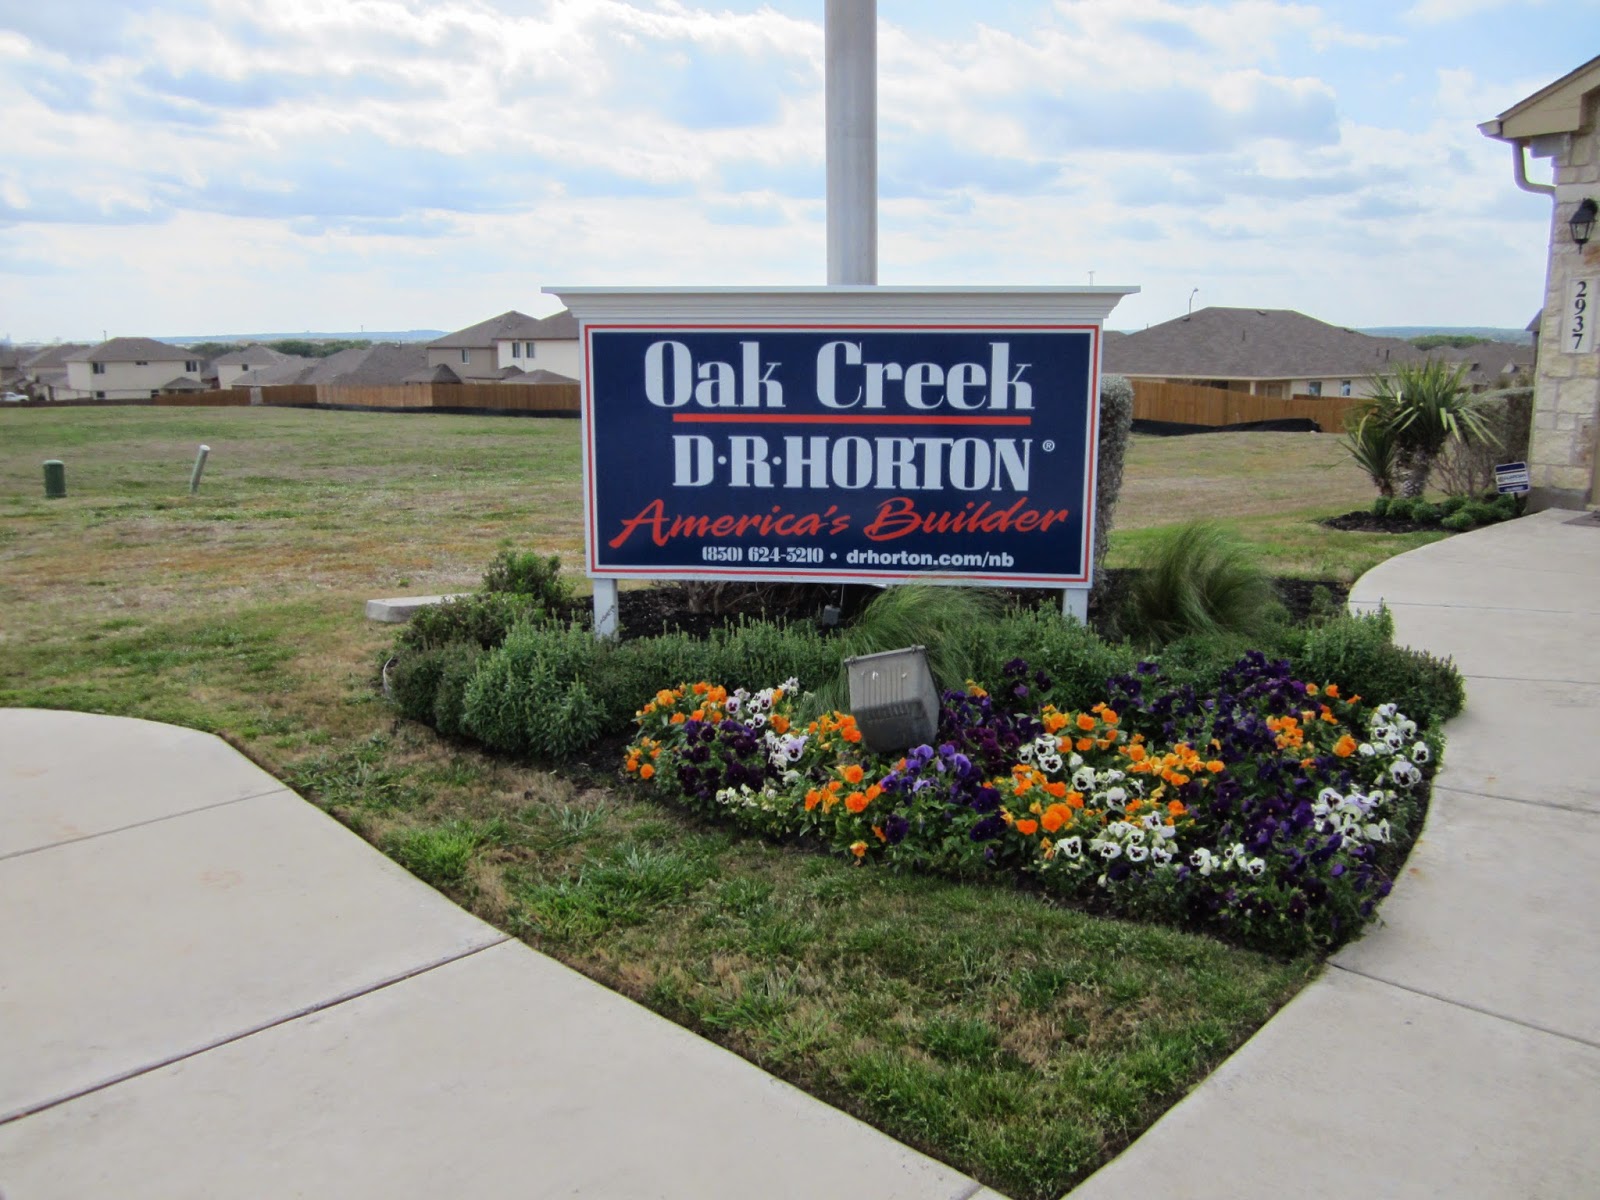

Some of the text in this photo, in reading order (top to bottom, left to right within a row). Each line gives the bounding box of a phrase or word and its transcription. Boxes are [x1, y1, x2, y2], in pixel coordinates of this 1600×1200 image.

[1572, 281, 1587, 349] 2937
[644, 340, 1035, 410] Oak Creek
[608, 497, 1069, 549] America's Builder
[846, 549, 1015, 568] drhorton.com/nb
